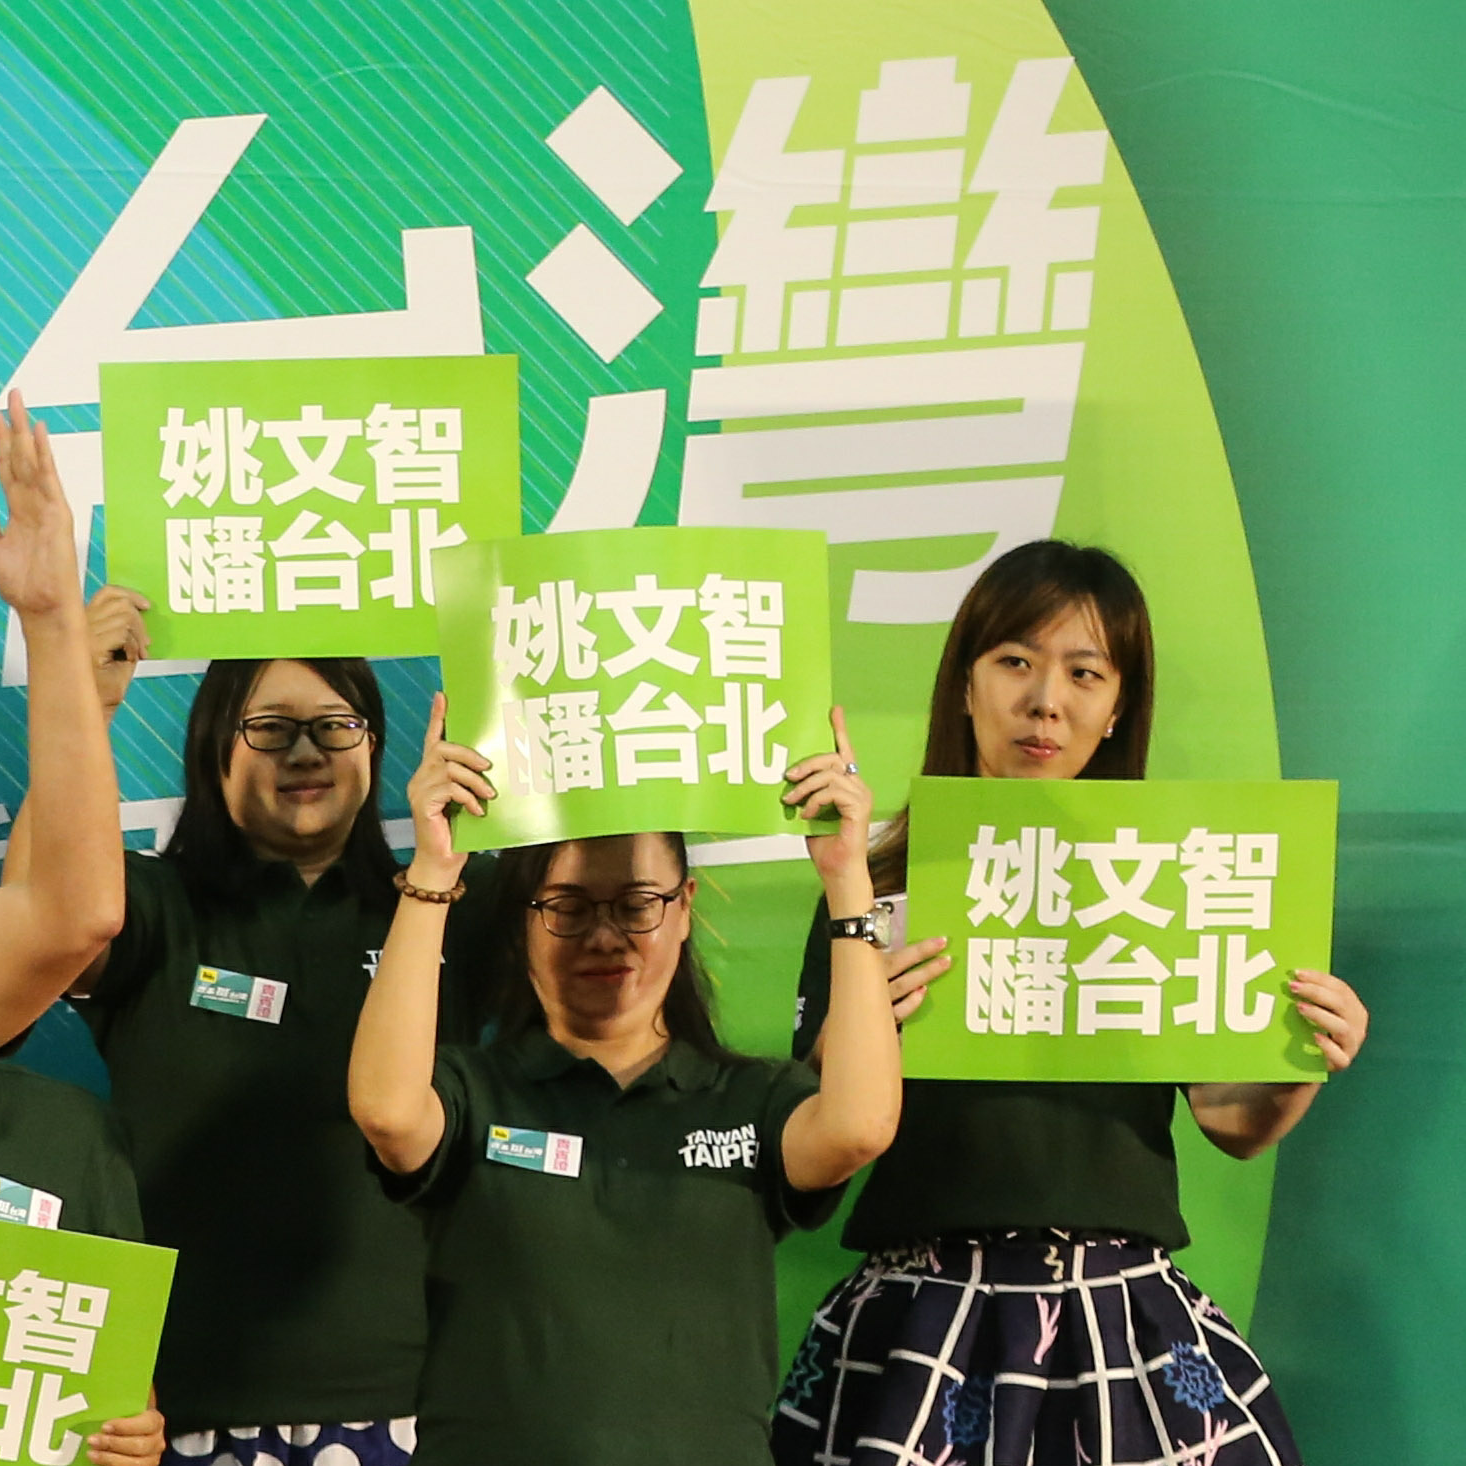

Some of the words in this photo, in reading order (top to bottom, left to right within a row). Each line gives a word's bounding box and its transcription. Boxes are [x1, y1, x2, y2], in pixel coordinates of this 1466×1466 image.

[158, 404, 465, 509] 姚文智
[492, 573, 785, 688] 姚文智
[964, 824, 1278, 930] 姚文智
[685, 1123, 757, 1146] TAIWAN
